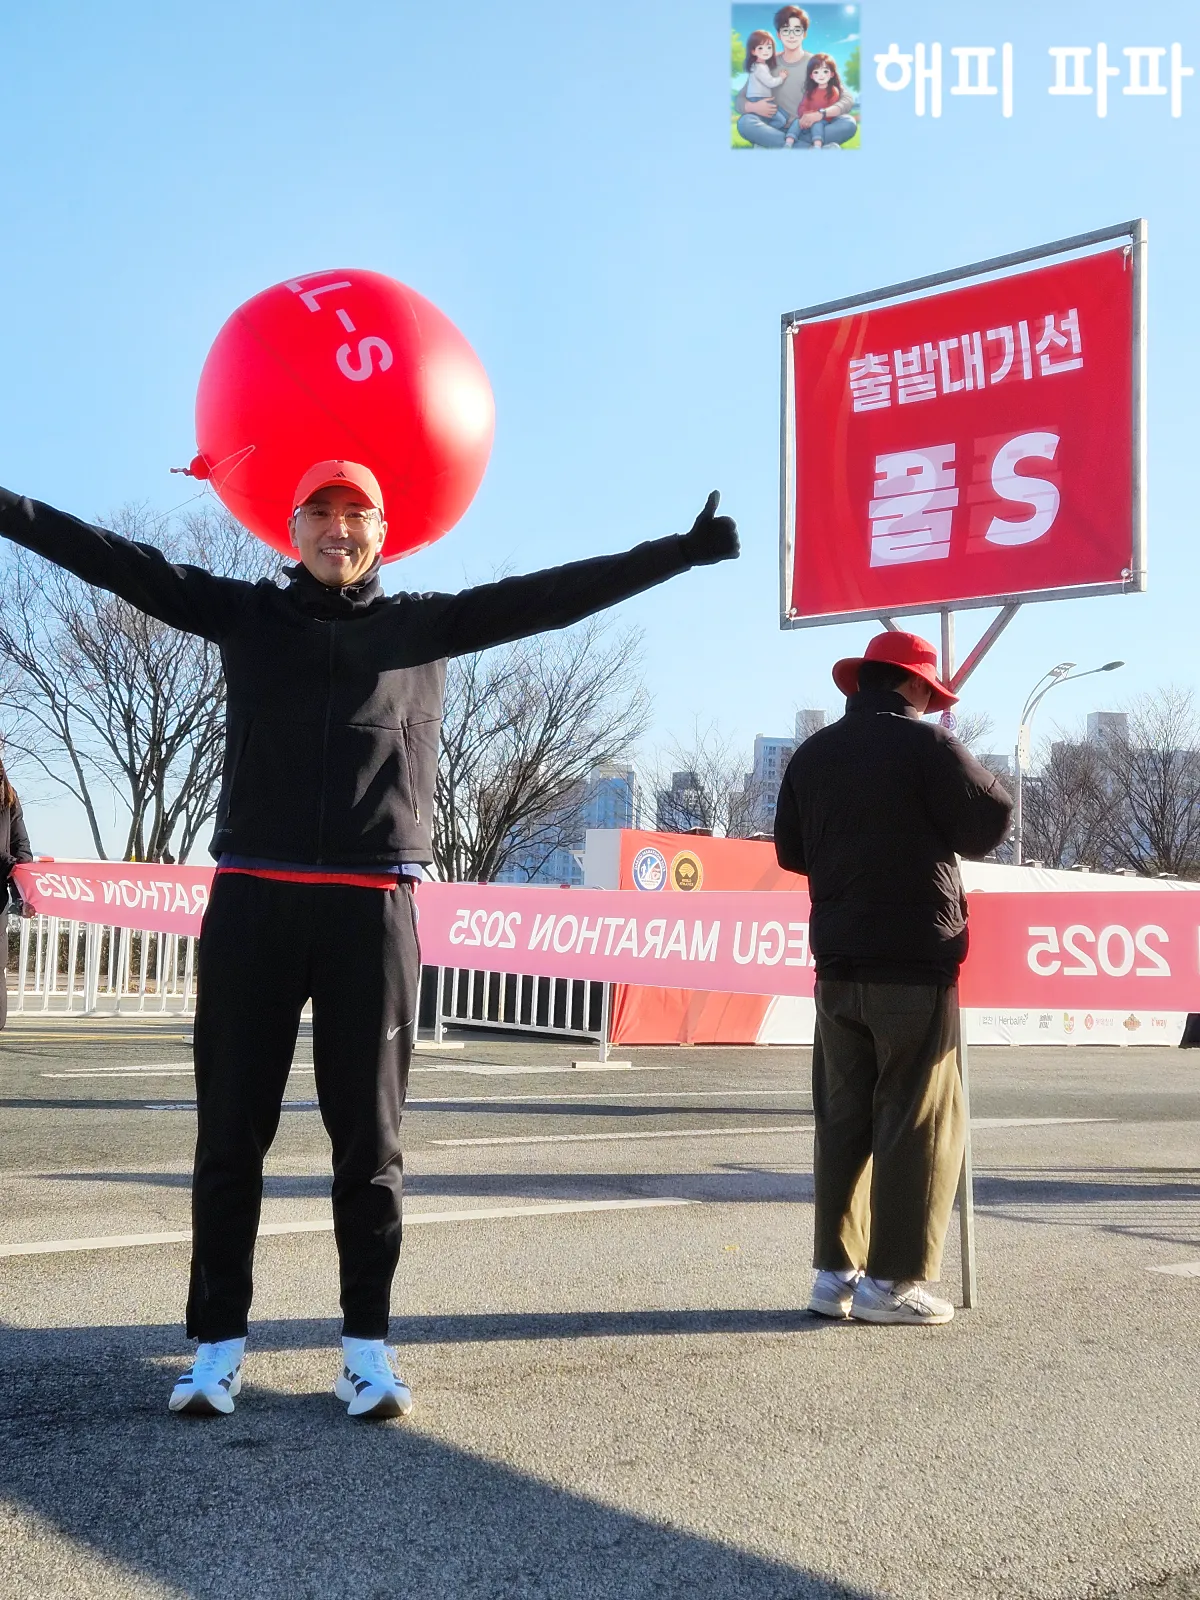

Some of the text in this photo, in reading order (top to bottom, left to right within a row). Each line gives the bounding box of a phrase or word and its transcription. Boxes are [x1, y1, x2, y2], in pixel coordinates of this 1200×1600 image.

[849, 308, 1084, 413] 출발대기선
[985, 432, 1061, 546] S
[998, 1015, 1027, 1026] Herbalife
